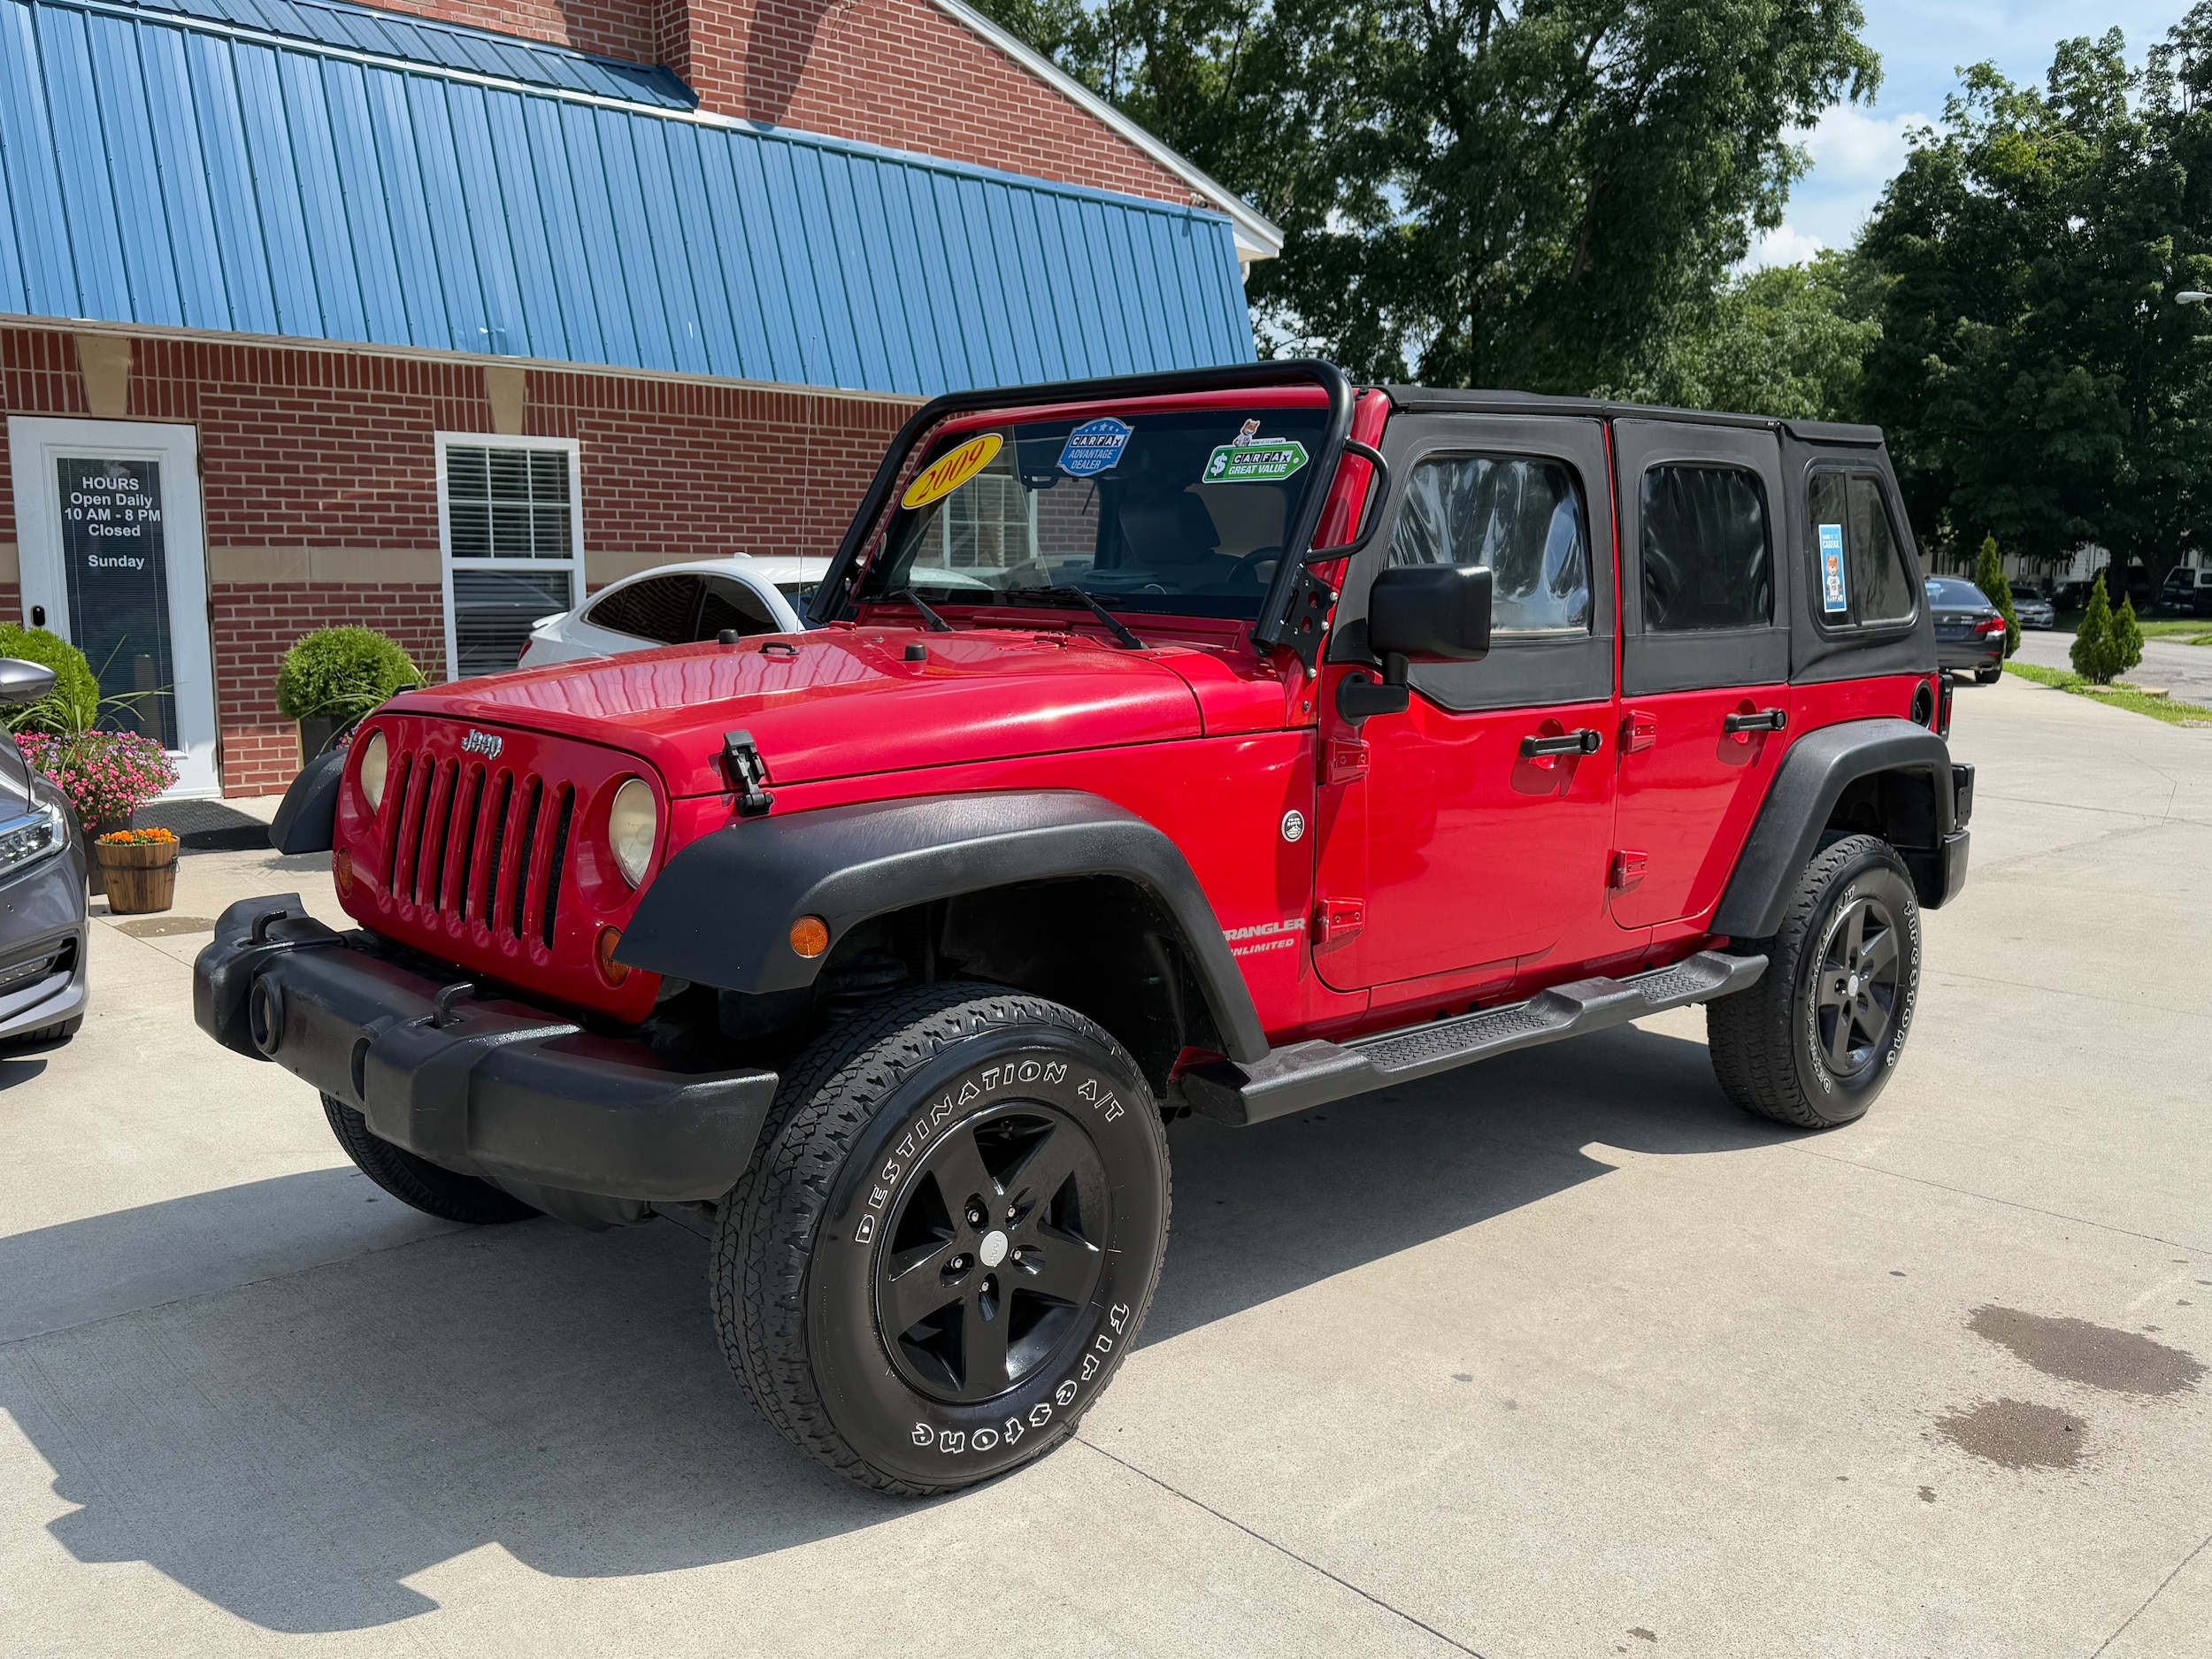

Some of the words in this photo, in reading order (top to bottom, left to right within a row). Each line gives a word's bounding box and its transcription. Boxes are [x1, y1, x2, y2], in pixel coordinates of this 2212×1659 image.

[1070, 434, 1125, 447] CARFAX
[1068, 449, 1114, 459] ADVANTAGE
[1232, 450, 1294, 465] CARFAX
[915, 441, 986, 503] 2009
[1071, 460, 1102, 470] DEALER
[1228, 465, 1257, 475] GREAT
[1258, 464, 1287, 474] VALUE
[82, 476, 140, 491] HOURS
[71, 492, 111, 508] Open
[115, 493, 153, 510] Daily
[65, 507, 83, 520] 10
[86, 508, 111, 521] AM
[125, 509, 134, 521] 8
[138, 509, 161, 522] PM
[88, 523, 142, 537] Closed
[88, 554, 145, 571] Sunday
[461, 728, 503, 761] Jeep
[1223, 917, 1306, 941] RANGLER
[1230, 938, 1294, 956] NLIMITED
[855, 1061, 1068, 1243] DESTINATION
[1077, 1078, 1125, 1123] A/T
[910, 1302, 1131, 1454] Firestone
